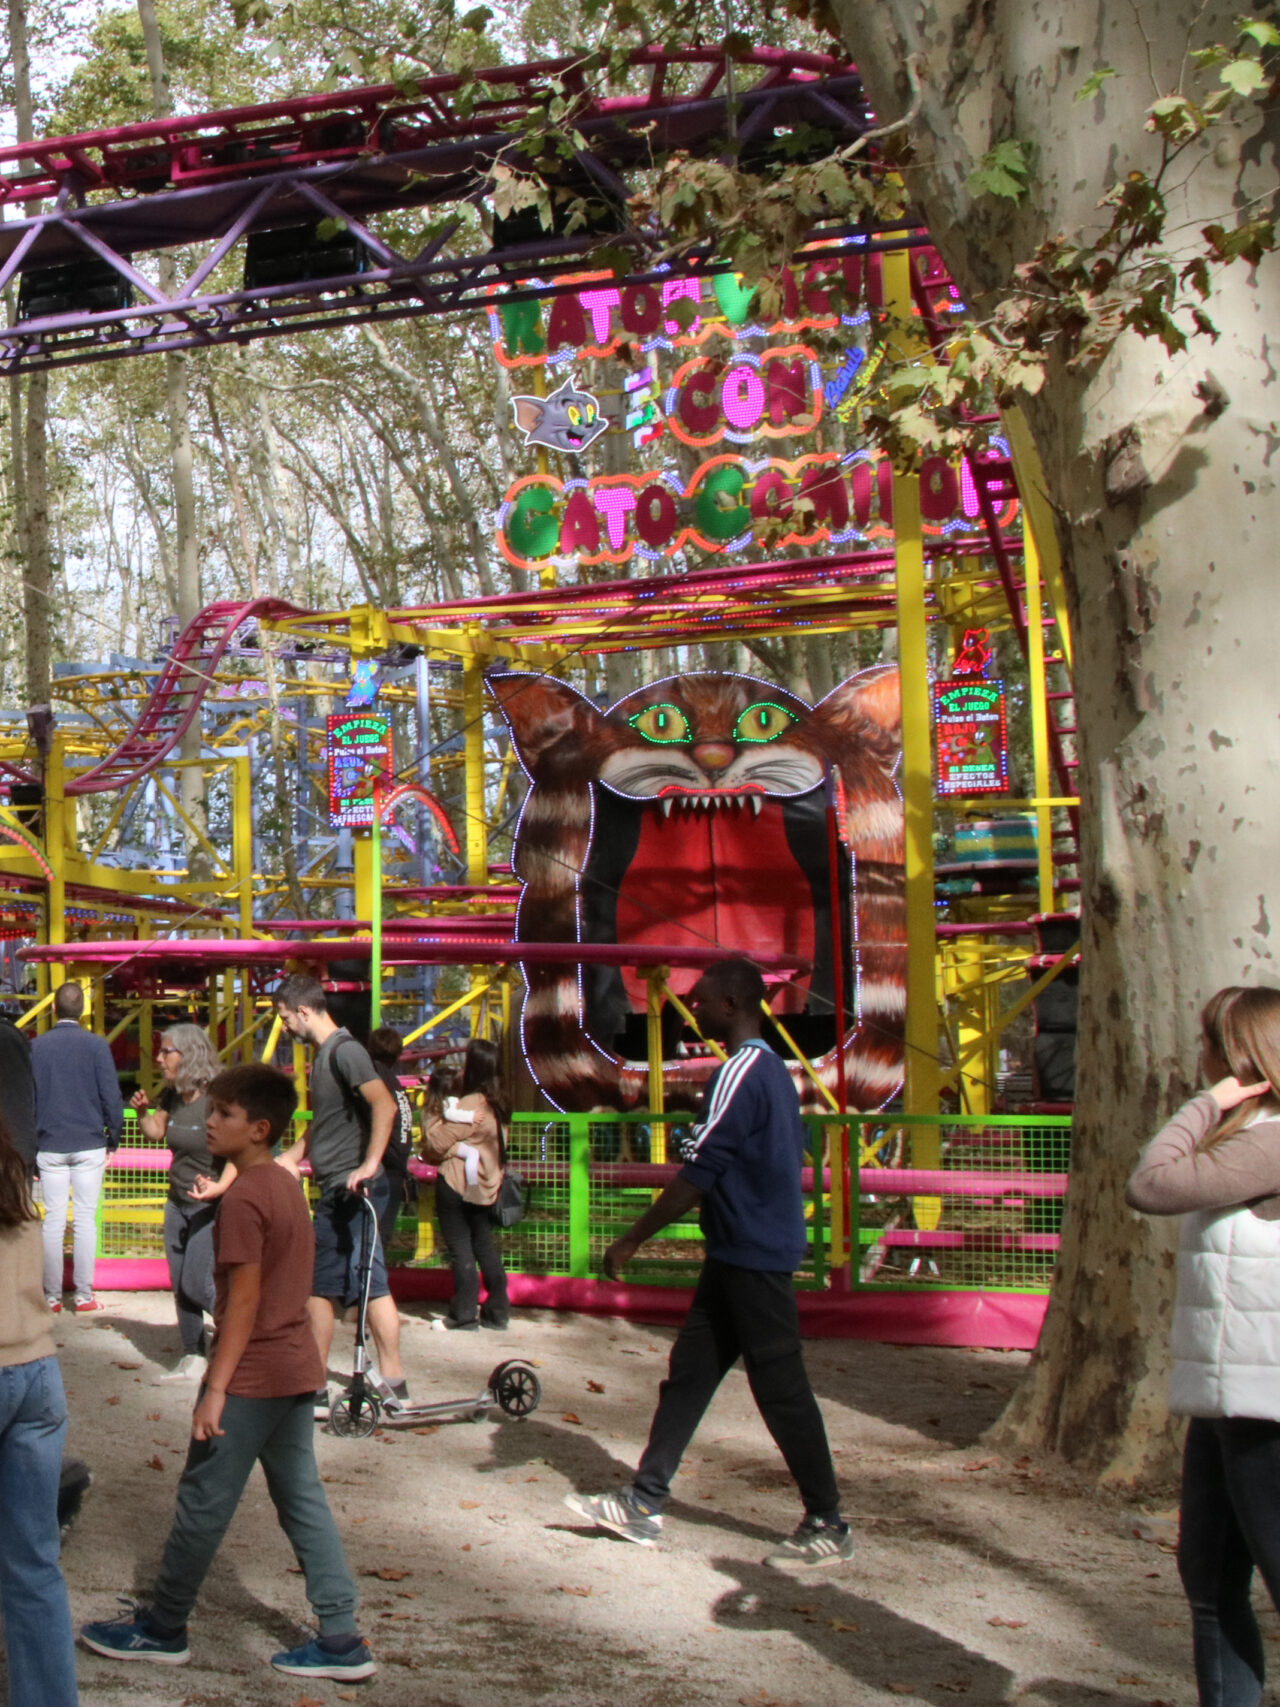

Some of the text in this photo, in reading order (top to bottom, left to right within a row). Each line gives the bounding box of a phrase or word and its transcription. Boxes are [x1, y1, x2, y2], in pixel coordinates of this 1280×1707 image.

[680, 357, 807, 434] CON
[509, 485, 677, 557] GATO
[939, 687, 999, 706] EMPIEZA
[948, 701, 990, 712] EL JUEGO
[333, 719, 388, 739] EMPIEZA
[943, 723, 976, 735] ROJO
[341, 733, 380, 745] EL JUEGO
[943, 779, 1001, 790] ESPECIALES
[948, 772, 995, 782] EFECTOS
[395, 1090, 408, 1144] ARMOUR
